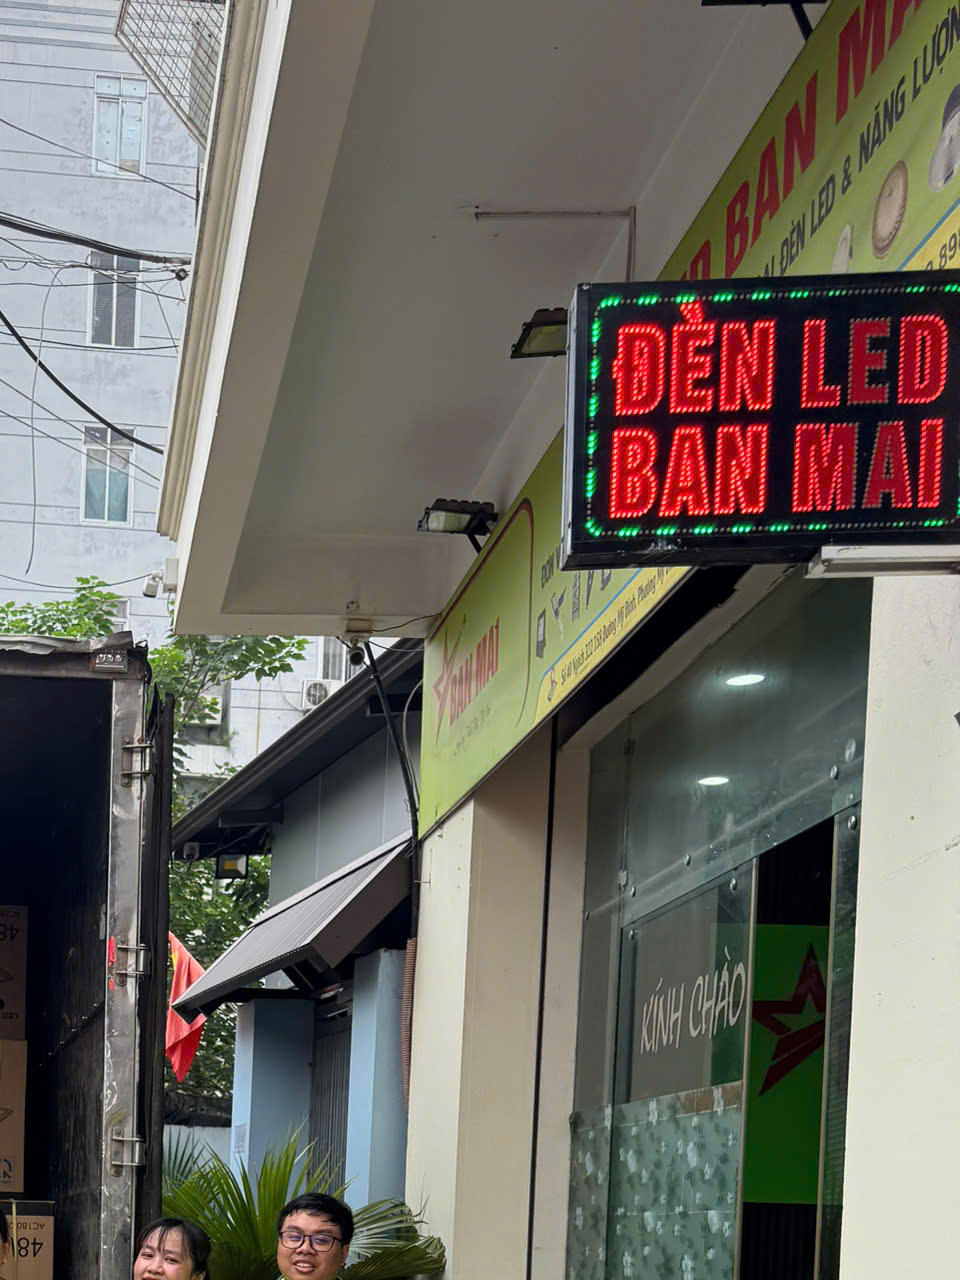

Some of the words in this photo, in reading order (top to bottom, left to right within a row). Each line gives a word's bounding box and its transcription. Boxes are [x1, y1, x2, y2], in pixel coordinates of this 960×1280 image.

[724, 69, 818, 281] BAN
[810, 174, 836, 239] LED
[841, 155, 852, 196] &
[611, 300, 777, 417] ĐÈN
[800, 314, 949, 409] LED
[609, 423, 769, 519] BAN
[791, 417, 945, 513] MAI
[449, 652, 473, 728] BAN
[474, 616, 500, 697] MAI
[640, 977, 685, 1055] KÍNH
[689, 945, 746, 1040] CHÀO
